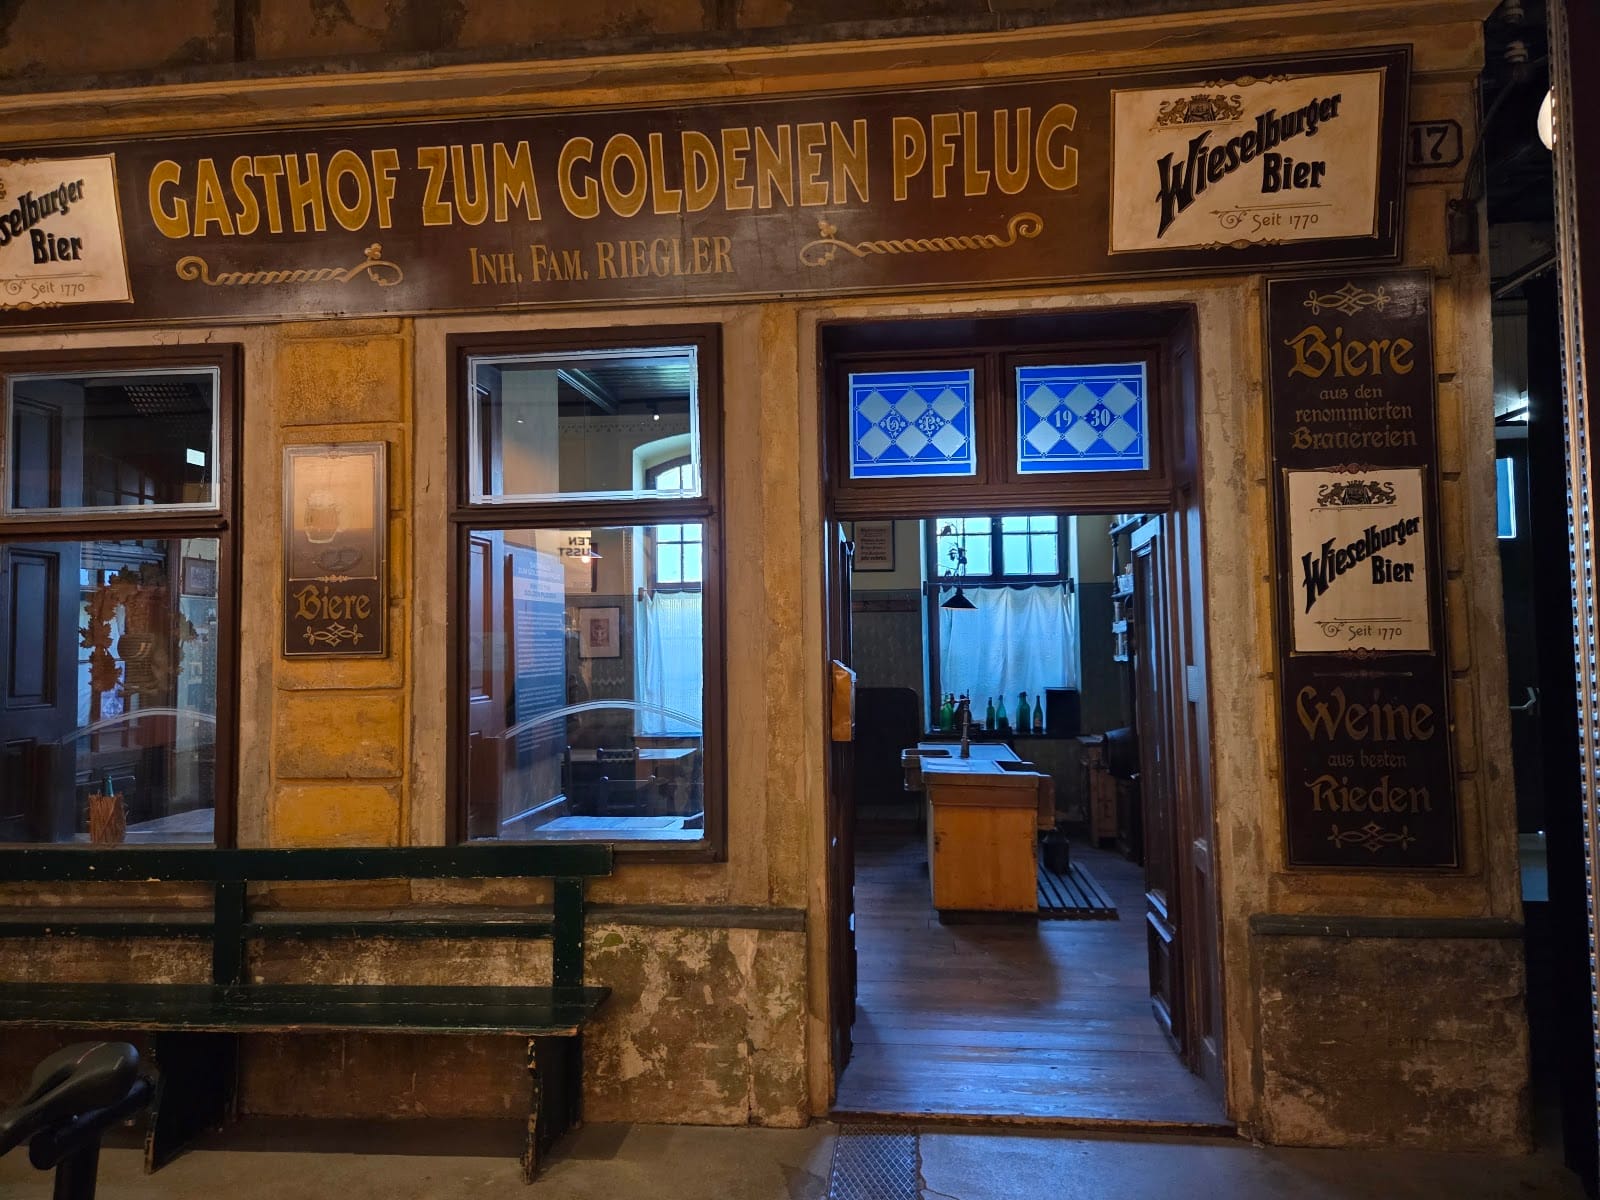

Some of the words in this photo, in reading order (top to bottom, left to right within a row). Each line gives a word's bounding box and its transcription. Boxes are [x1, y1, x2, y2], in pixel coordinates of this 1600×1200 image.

[148, 149, 399, 239] GASTHOF
[417, 140, 541, 226] ZUM
[557, 119, 869, 219] GOLDENEN
[893, 103, 1078, 202] PFLUG
[1155, 93, 1342, 239] Wieselburger
[1261, 152, 1326, 193] Bier
[1251, 213, 1282, 233] Seit
[1289, 214, 1319, 230] 1770
[29, 229, 83, 264] Bier
[530, 244, 588, 283] FAM.
[596, 235, 735, 280] RIEGLER
[31, 282, 55, 299] Seit
[61, 283, 85, 296] 1770
[1283, 325, 1415, 378] Biere
[1320, 388, 1349, 400] aus
[1354, 384, 1383, 398] den
[1054, 410, 1072, 428] 19
[1090, 408, 1110, 427] 30
[1296, 401, 1413, 423] renommierten
[1289, 425, 1418, 449] Brauereien
[1302, 517, 1420, 614] Wieselburger
[1371, 555, 1414, 584] Bier
[293, 584, 371, 620] Biere
[1348, 626, 1372, 641] Seit
[1378, 627, 1402, 640] 1770
[1296, 685, 1435, 742] Weine
[1328, 753, 1354, 768] aus
[1360, 749, 1407, 768] besten
[1304, 774, 1432, 813] Rieden
